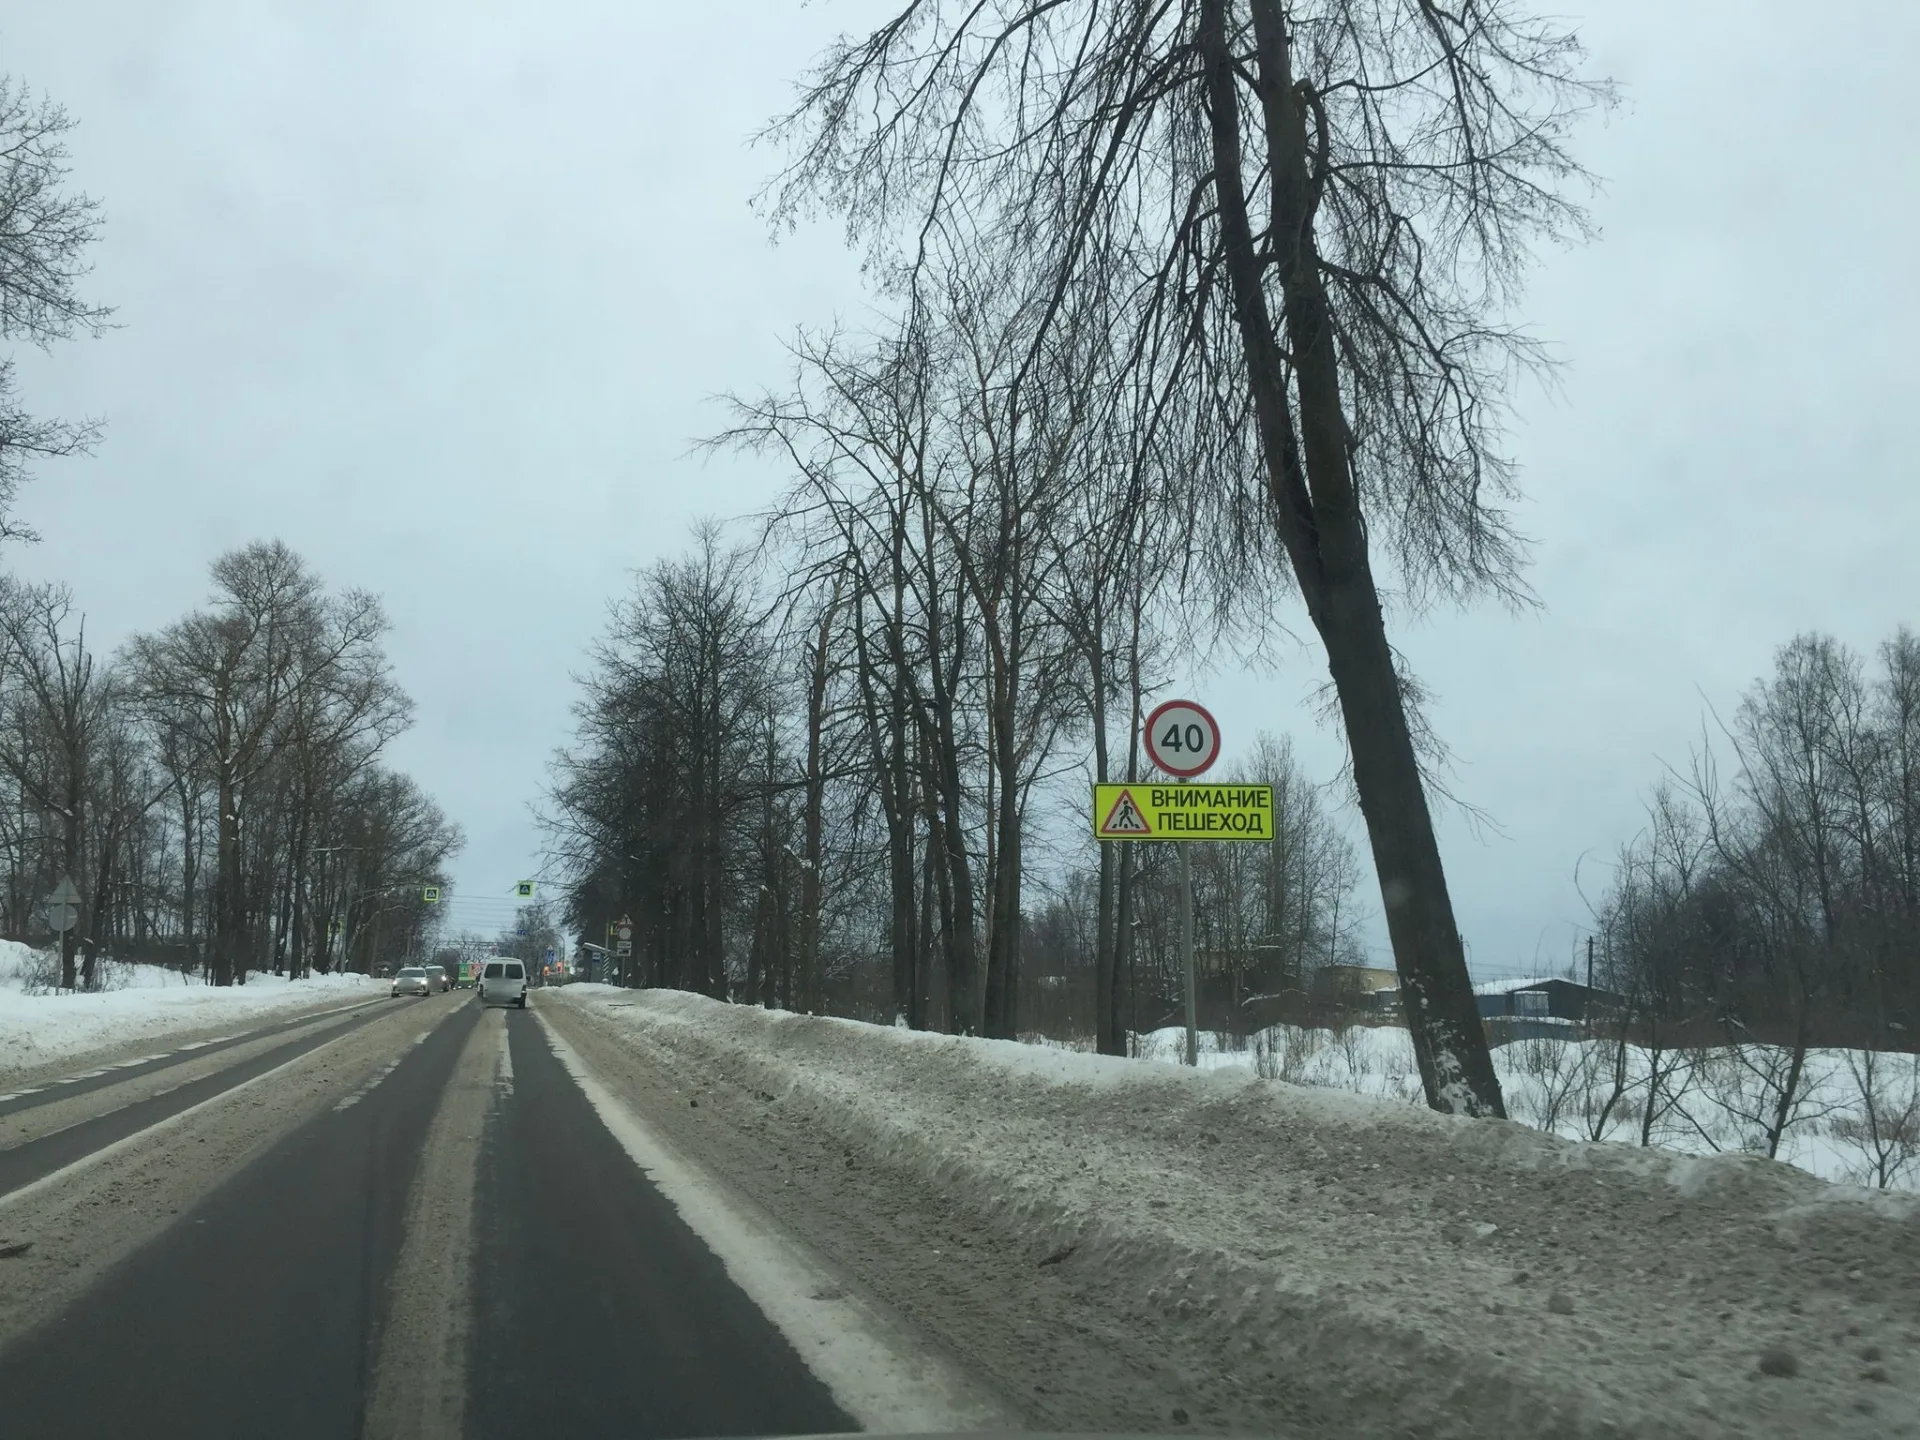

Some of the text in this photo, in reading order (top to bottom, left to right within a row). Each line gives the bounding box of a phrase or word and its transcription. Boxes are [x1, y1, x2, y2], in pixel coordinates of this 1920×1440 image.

[1161, 724, 1204, 753] 40
[1151, 789, 1269, 808] ВНИМАНИЕ
[1158, 812, 1263, 834] ПЕШЕХОД
